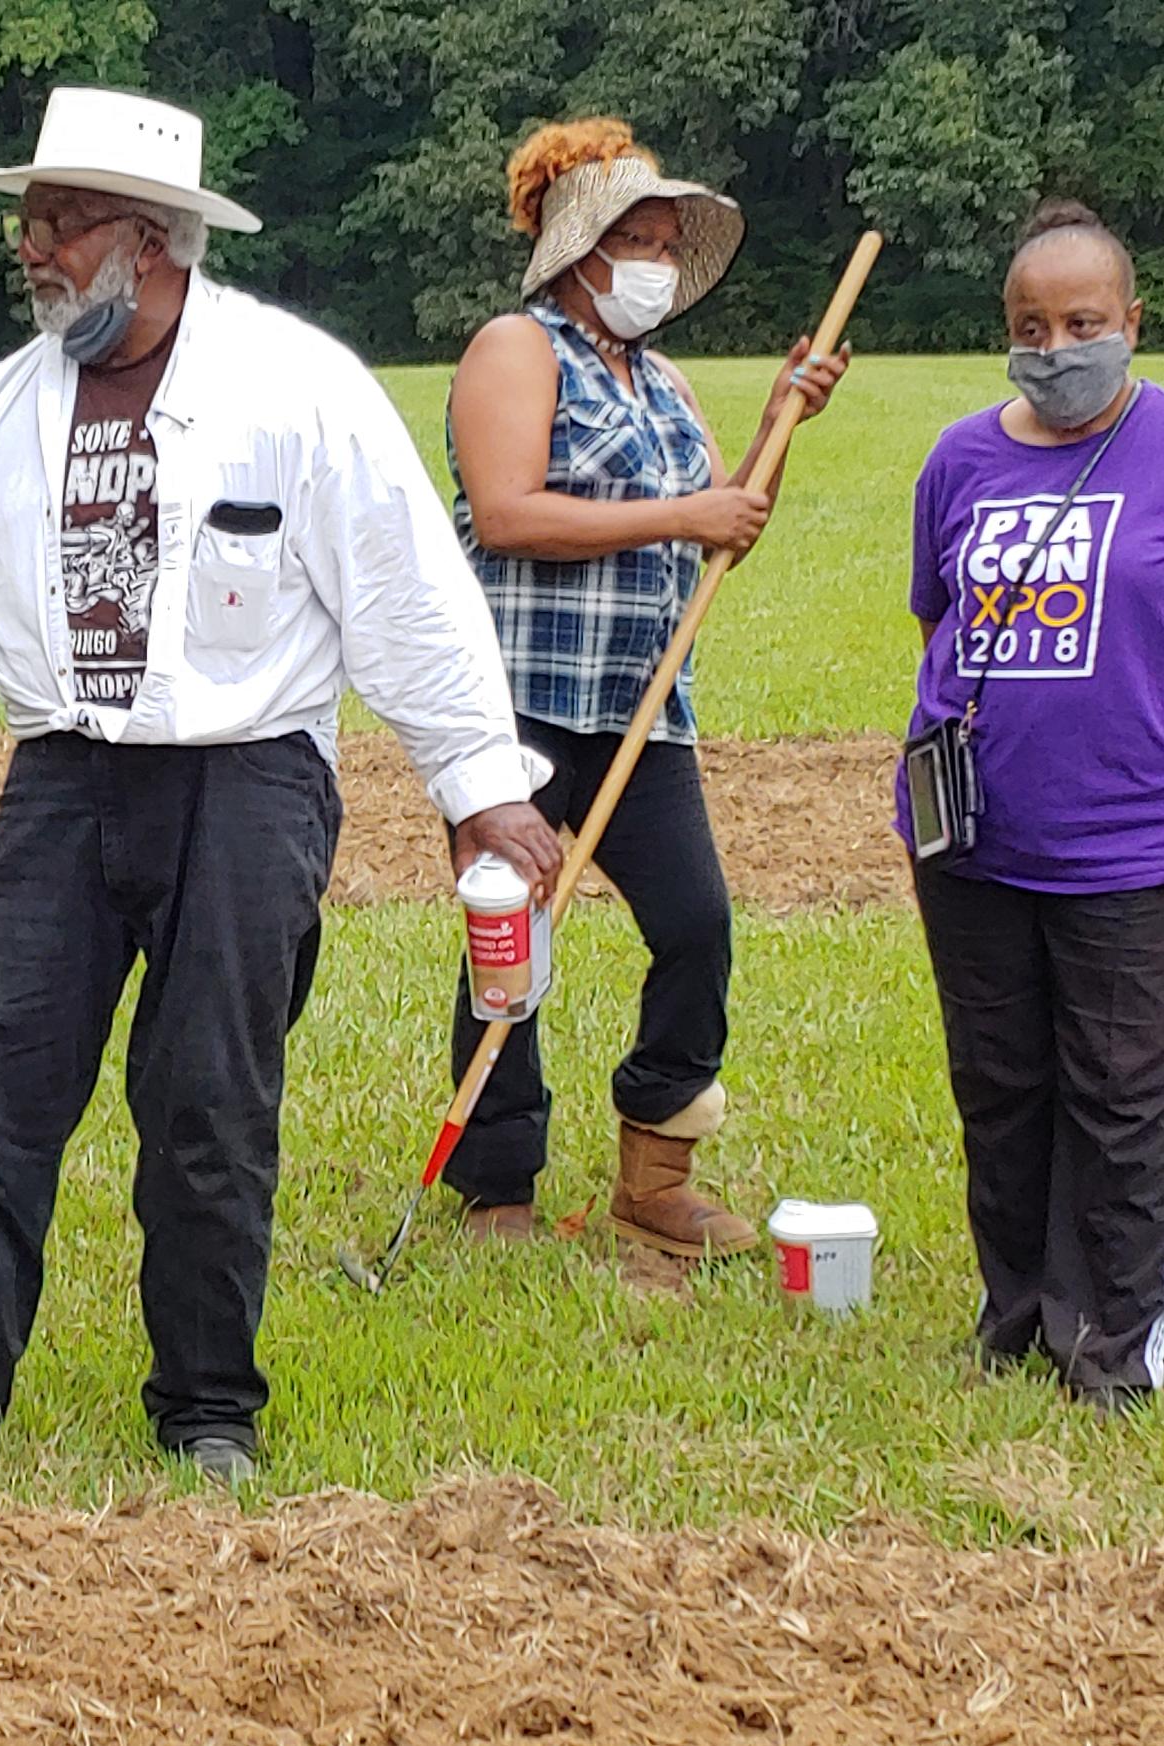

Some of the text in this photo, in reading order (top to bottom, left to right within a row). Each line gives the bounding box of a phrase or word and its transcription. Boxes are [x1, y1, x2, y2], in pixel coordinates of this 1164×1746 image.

[71, 420, 132, 453] SOME
[979, 506, 1092, 544] PTA
[968, 541, 1091, 583] CON
[970, 583, 1086, 628] XPO
[969, 627, 1079, 663] 2018
